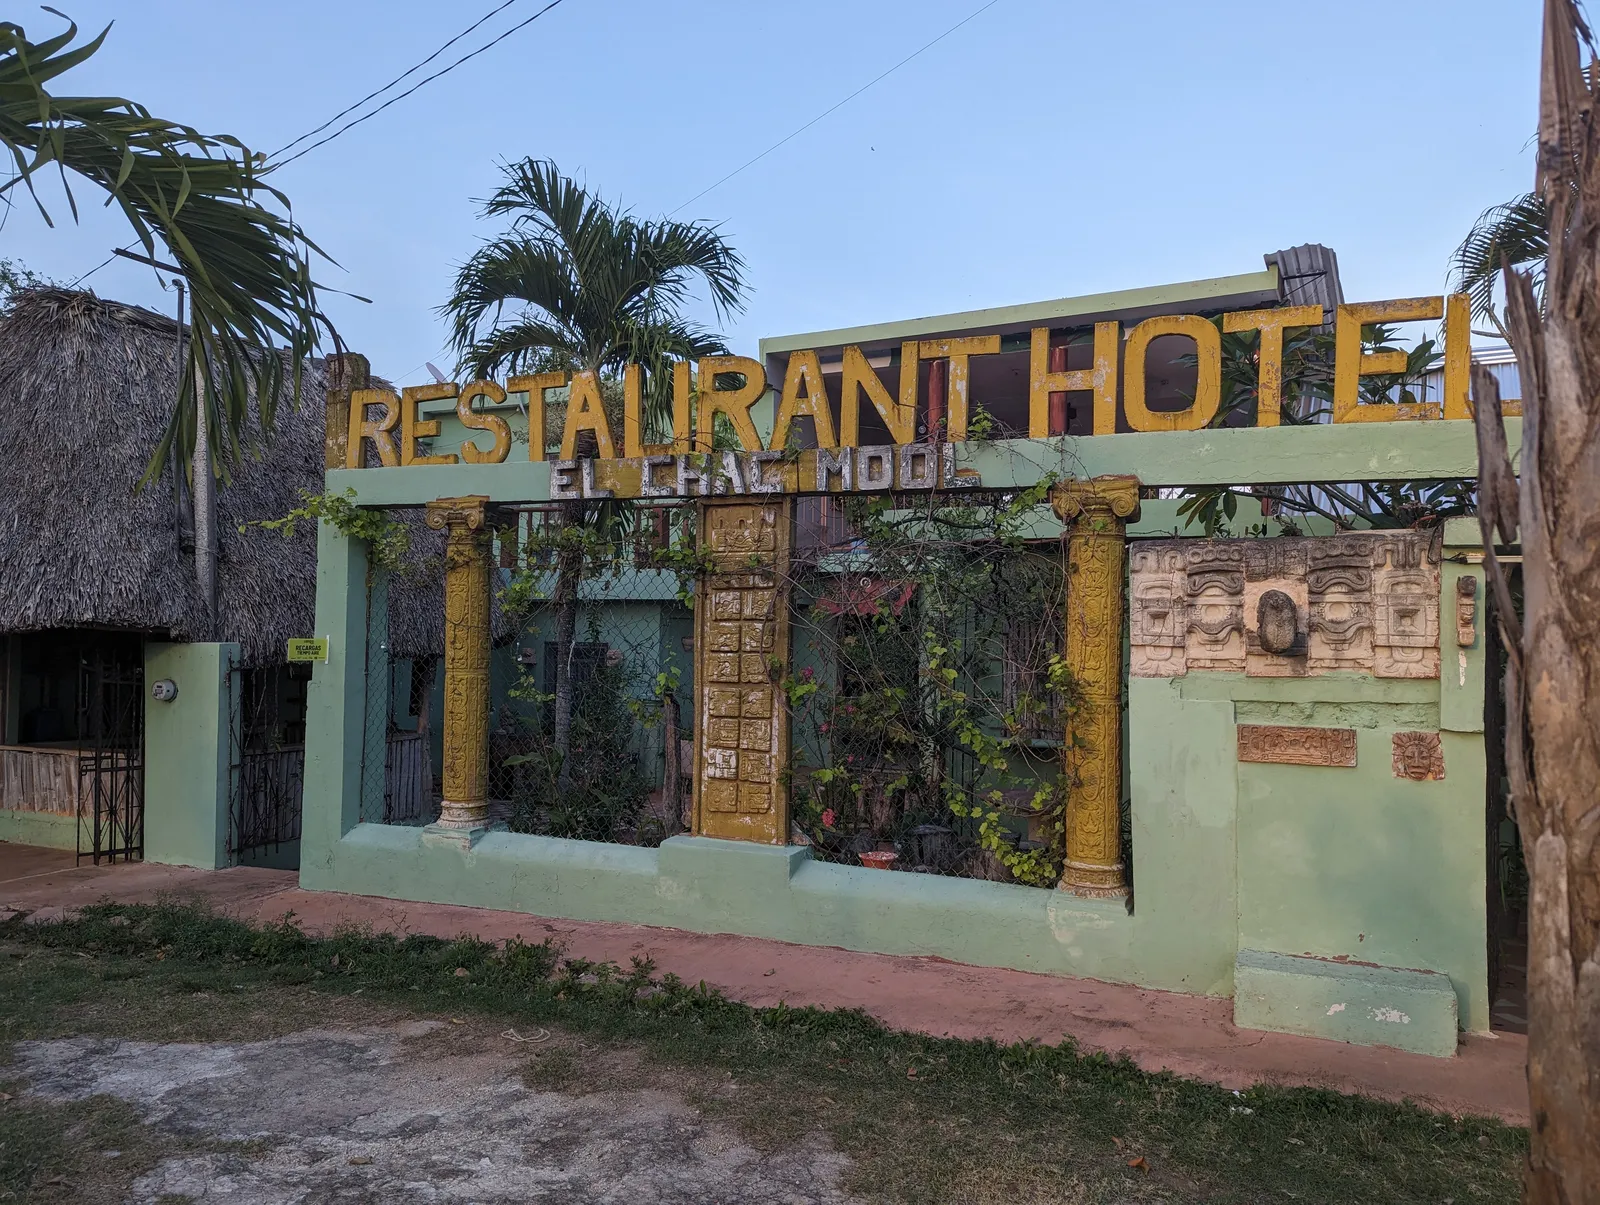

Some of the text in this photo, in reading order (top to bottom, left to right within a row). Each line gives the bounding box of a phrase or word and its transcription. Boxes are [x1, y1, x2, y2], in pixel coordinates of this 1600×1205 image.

[346, 293, 1522, 469] RESTAURANT HOTEL
[550, 442, 981, 500] EL CHAC MOOL
